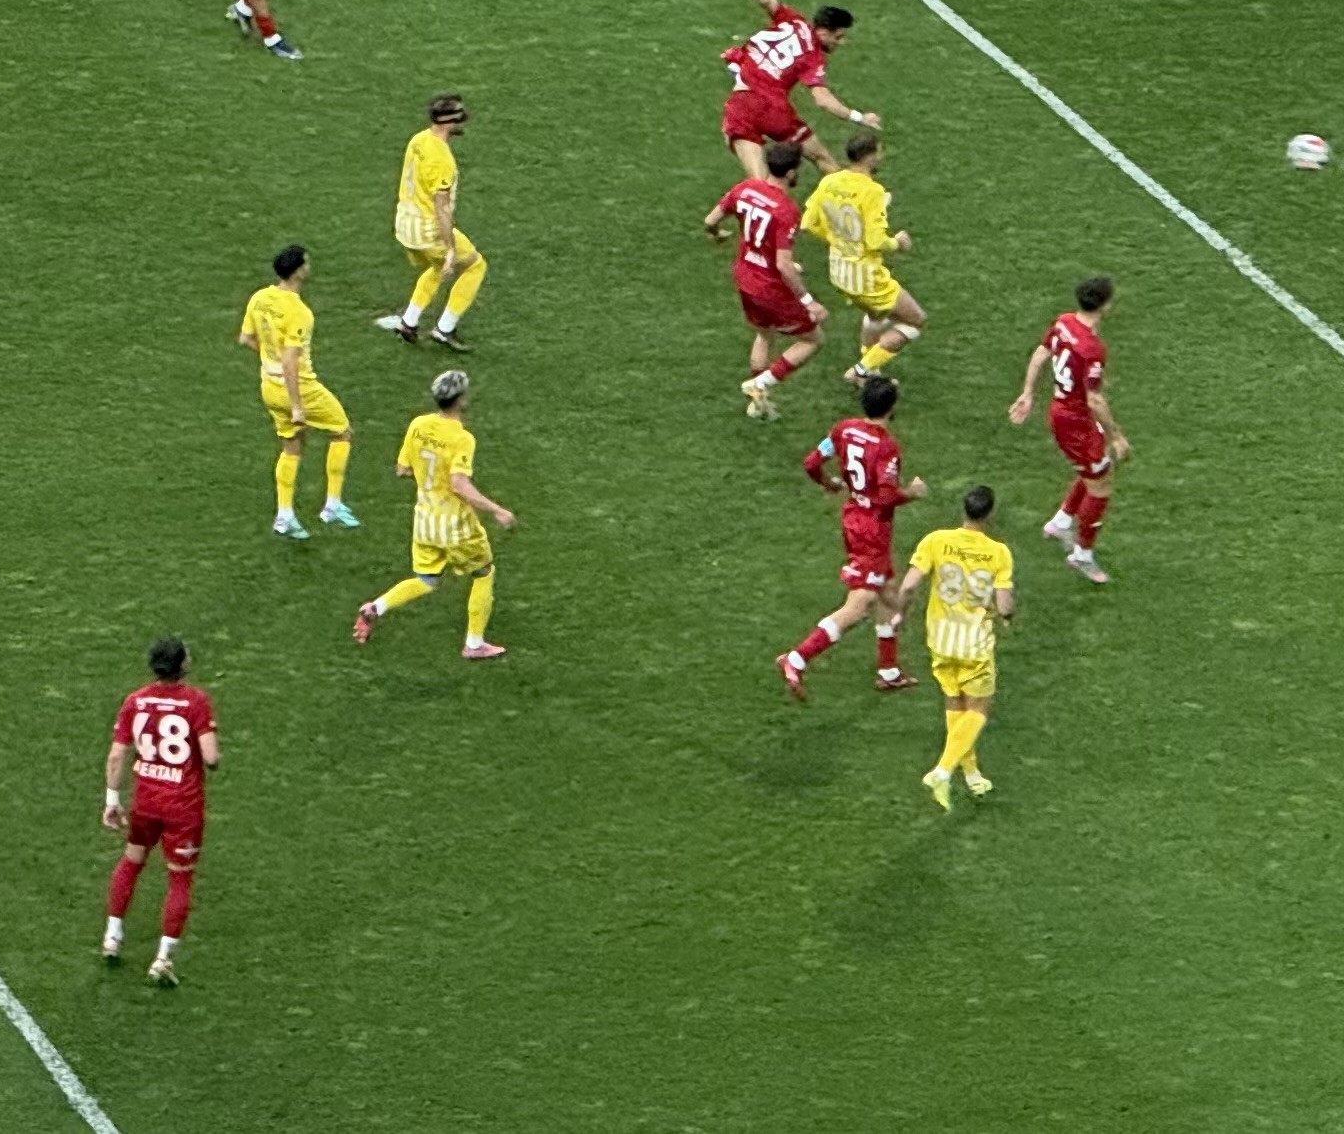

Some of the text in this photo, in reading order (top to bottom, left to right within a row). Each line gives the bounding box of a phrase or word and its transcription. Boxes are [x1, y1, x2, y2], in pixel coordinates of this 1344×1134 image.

[736, 199, 772, 248] 77
[847, 443, 866, 491] 5
[938, 561, 994, 607] 89
[132, 712, 191, 765] 48
